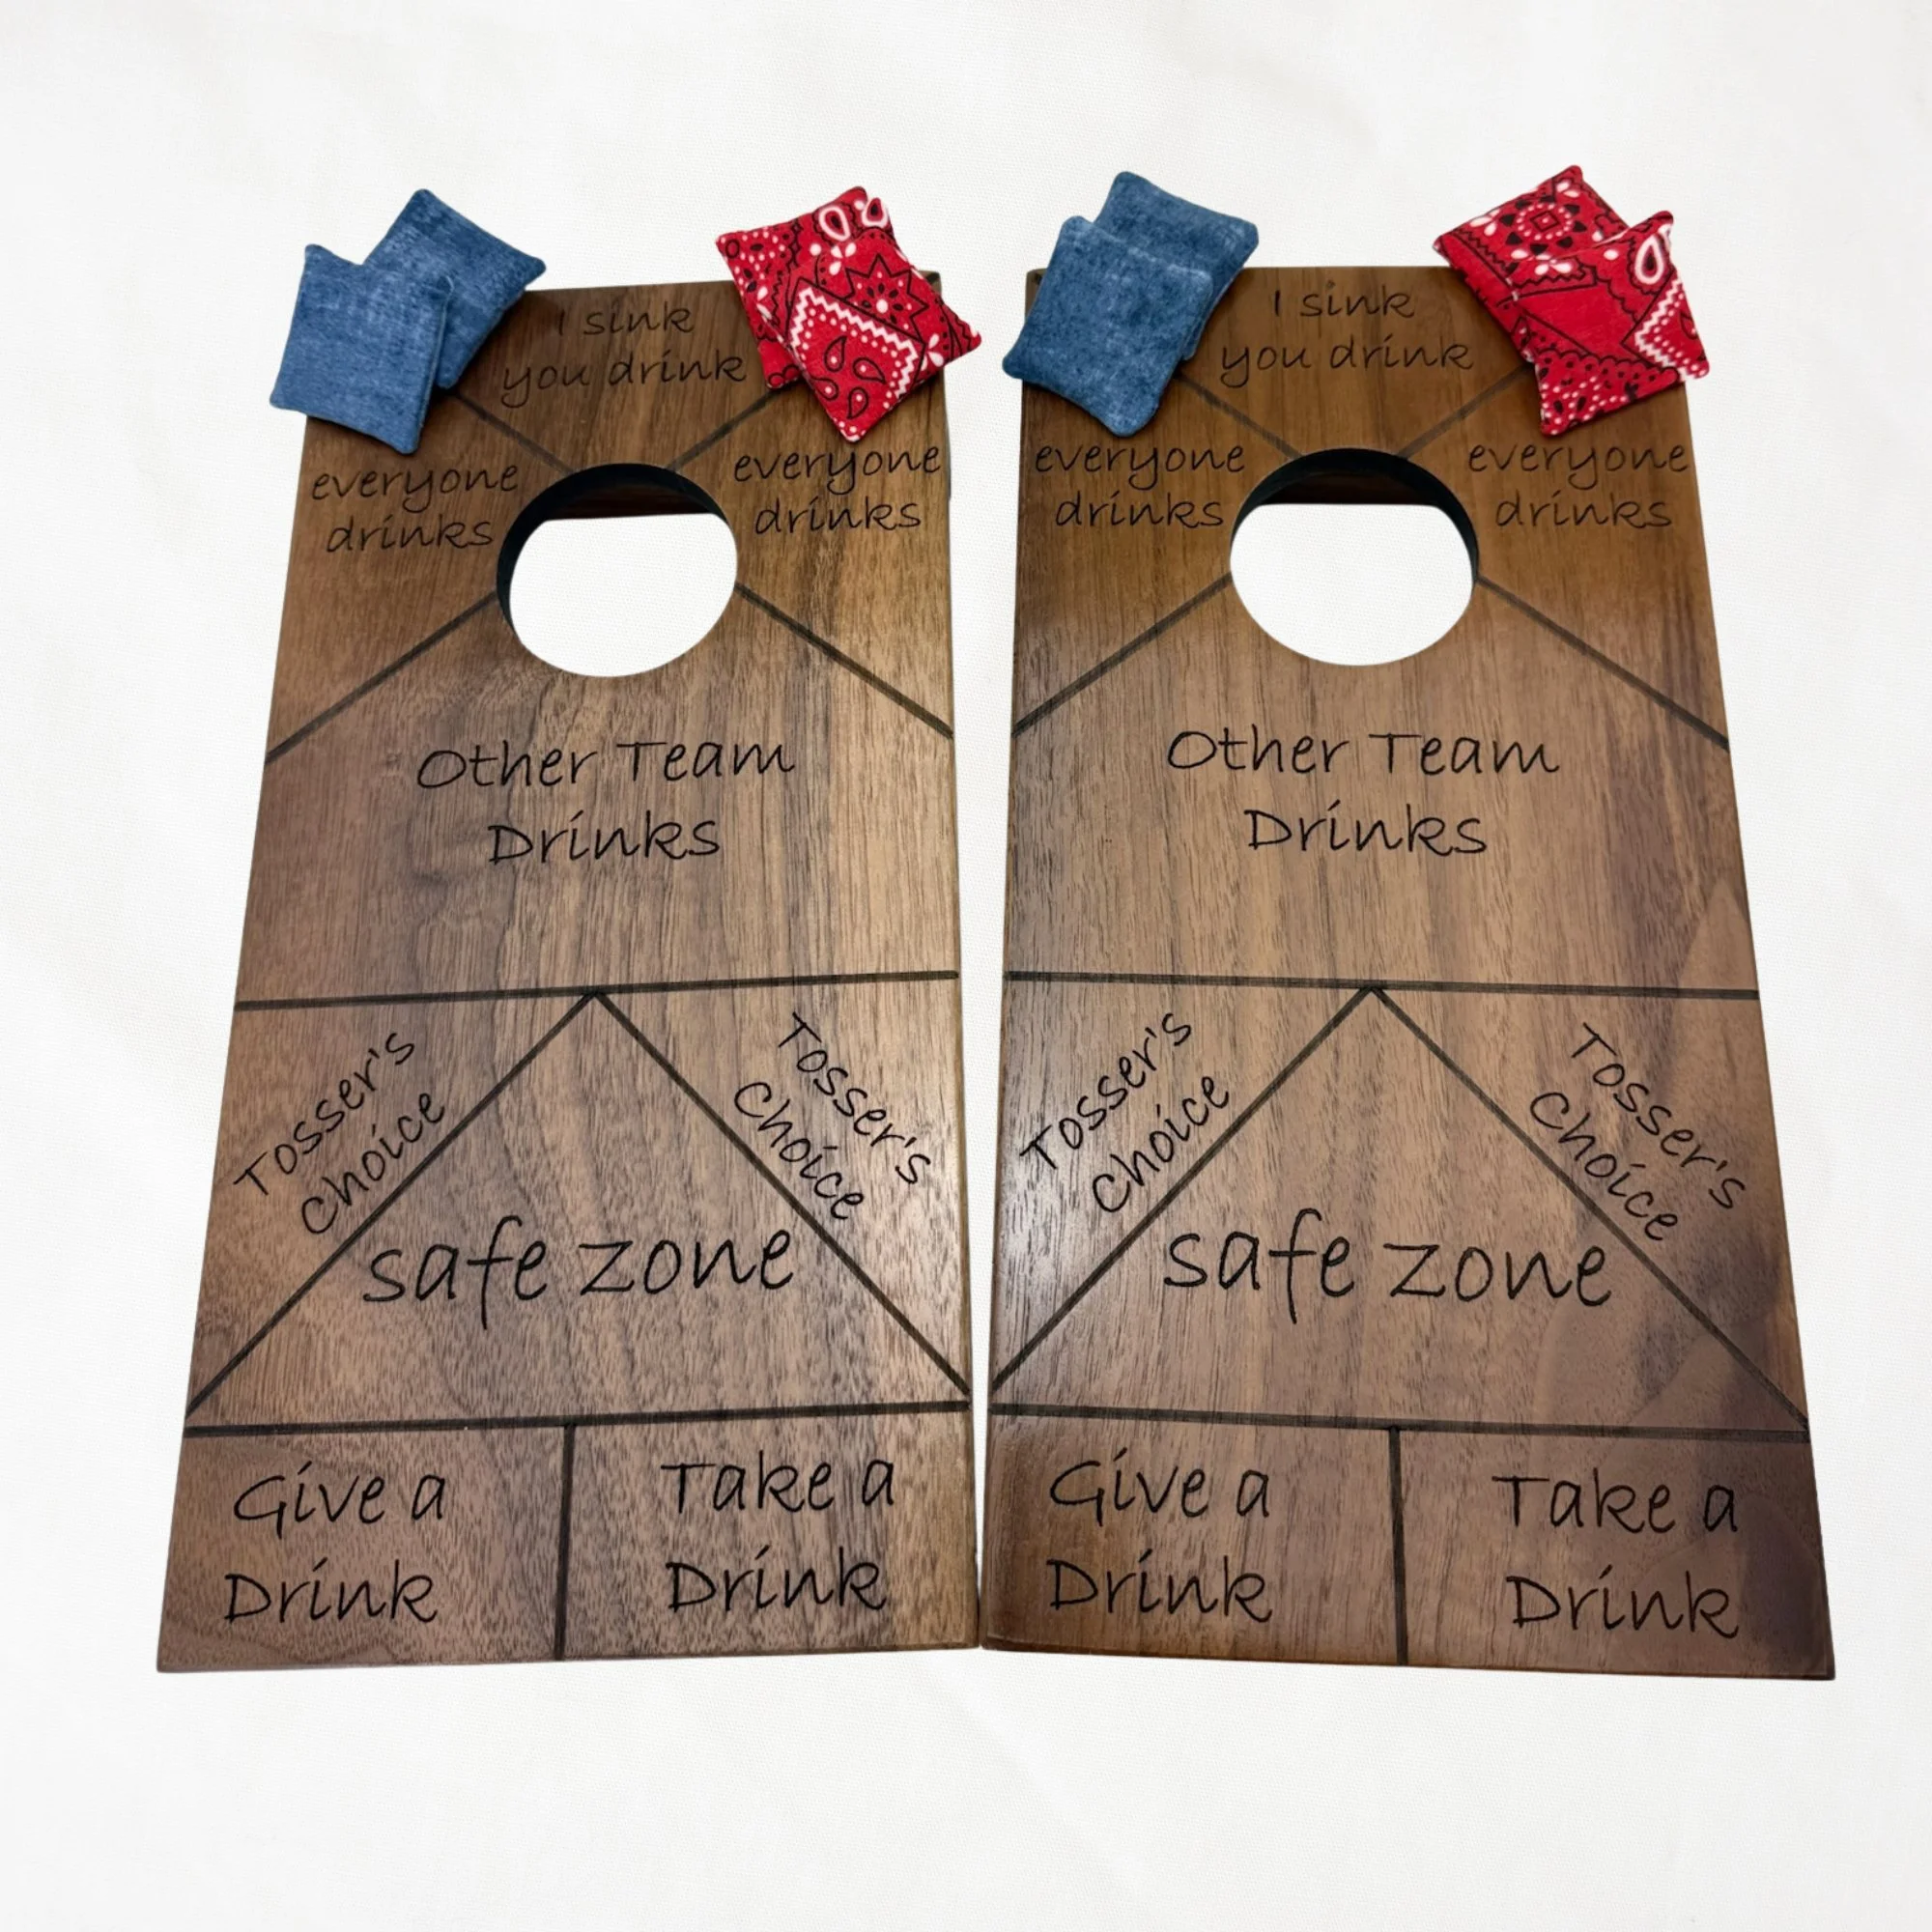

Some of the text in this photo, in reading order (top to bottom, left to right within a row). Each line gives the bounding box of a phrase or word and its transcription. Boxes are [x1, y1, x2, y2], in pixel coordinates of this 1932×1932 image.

[557, 299, 696, 336] I sink
[1273, 280, 1416, 319] I sink
[503, 348, 749, 409] you drink
[1222, 333, 1475, 387] you drink
[311, 463, 519, 514] everyone
[733, 442, 942, 495] everyone
[1034, 440, 1246, 487] everyone
[1468, 439, 1688, 489] everyone
[327, 515, 494, 553] drinks
[754, 496, 922, 535] drinks
[1055, 490, 1224, 529] drinks
[1495, 490, 1672, 529] drinks
[416, 740, 796, 789] Other Team
[1166, 724, 1560, 775] Other Team
[487, 810, 721, 866] Drinks
[1244, 801, 1490, 857] Drinks
[233, 1032, 415, 1198] Tosser's
[776, 1011, 931, 1185] Tosser's
[1019, 1011, 1192, 1174] Tosser's
[1570, 1023, 1746, 1211] Tosser's
[299, 1091, 445, 1235] Choice
[733, 1080, 866, 1221] Choice
[1092, 1073, 1231, 1214] Choice
[1528, 1090, 1680, 1241] Choice
[362, 1214, 795, 1330] safe zone
[1162, 1208, 1614, 1324] safe zone
[233, 1460, 447, 1539] Give a
[661, 1449, 895, 1516] Take a
[1048, 1447, 1270, 1528] Give a
[1492, 1467, 1740, 1535] Take a
[223, 1555, 439, 1625] Drink
[665, 1545, 887, 1613] Drink
[1045, 1548, 1274, 1625] Drink
[1506, 1564, 1740, 1639] Drink
